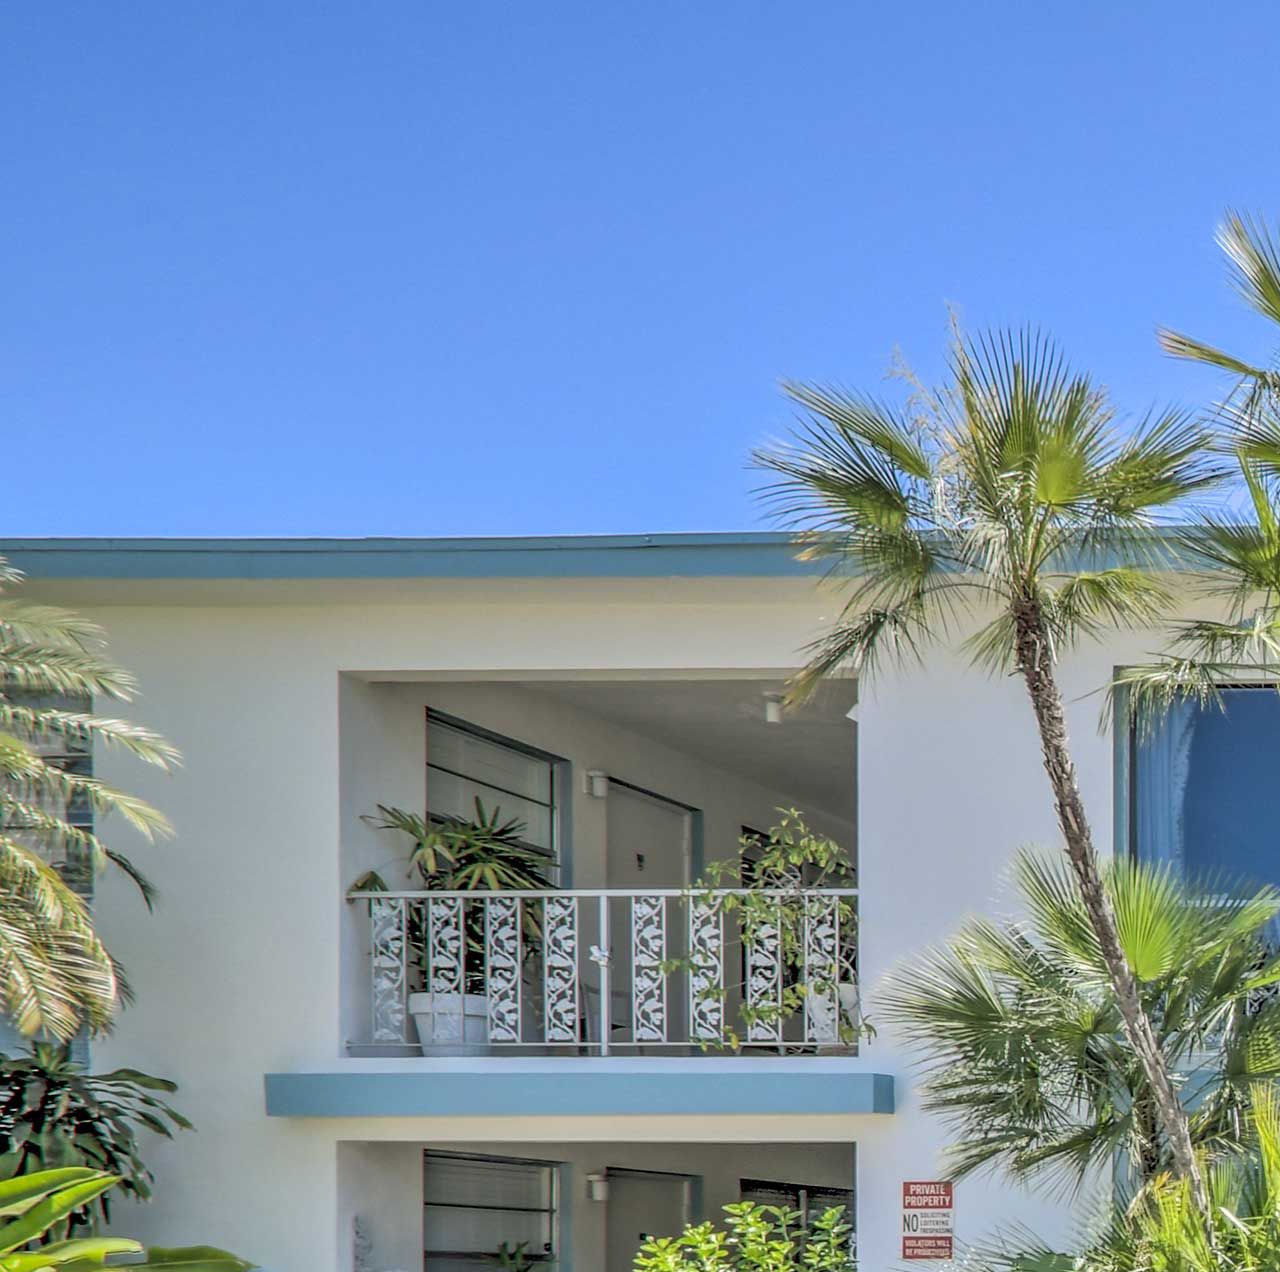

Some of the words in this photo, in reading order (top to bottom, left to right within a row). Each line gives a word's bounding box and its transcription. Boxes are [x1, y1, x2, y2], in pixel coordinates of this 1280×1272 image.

[909, 1184, 946, 1195] PRIVATE
[904, 1195, 951, 1207] PROPERTY
[903, 1214, 919, 1232] NO
